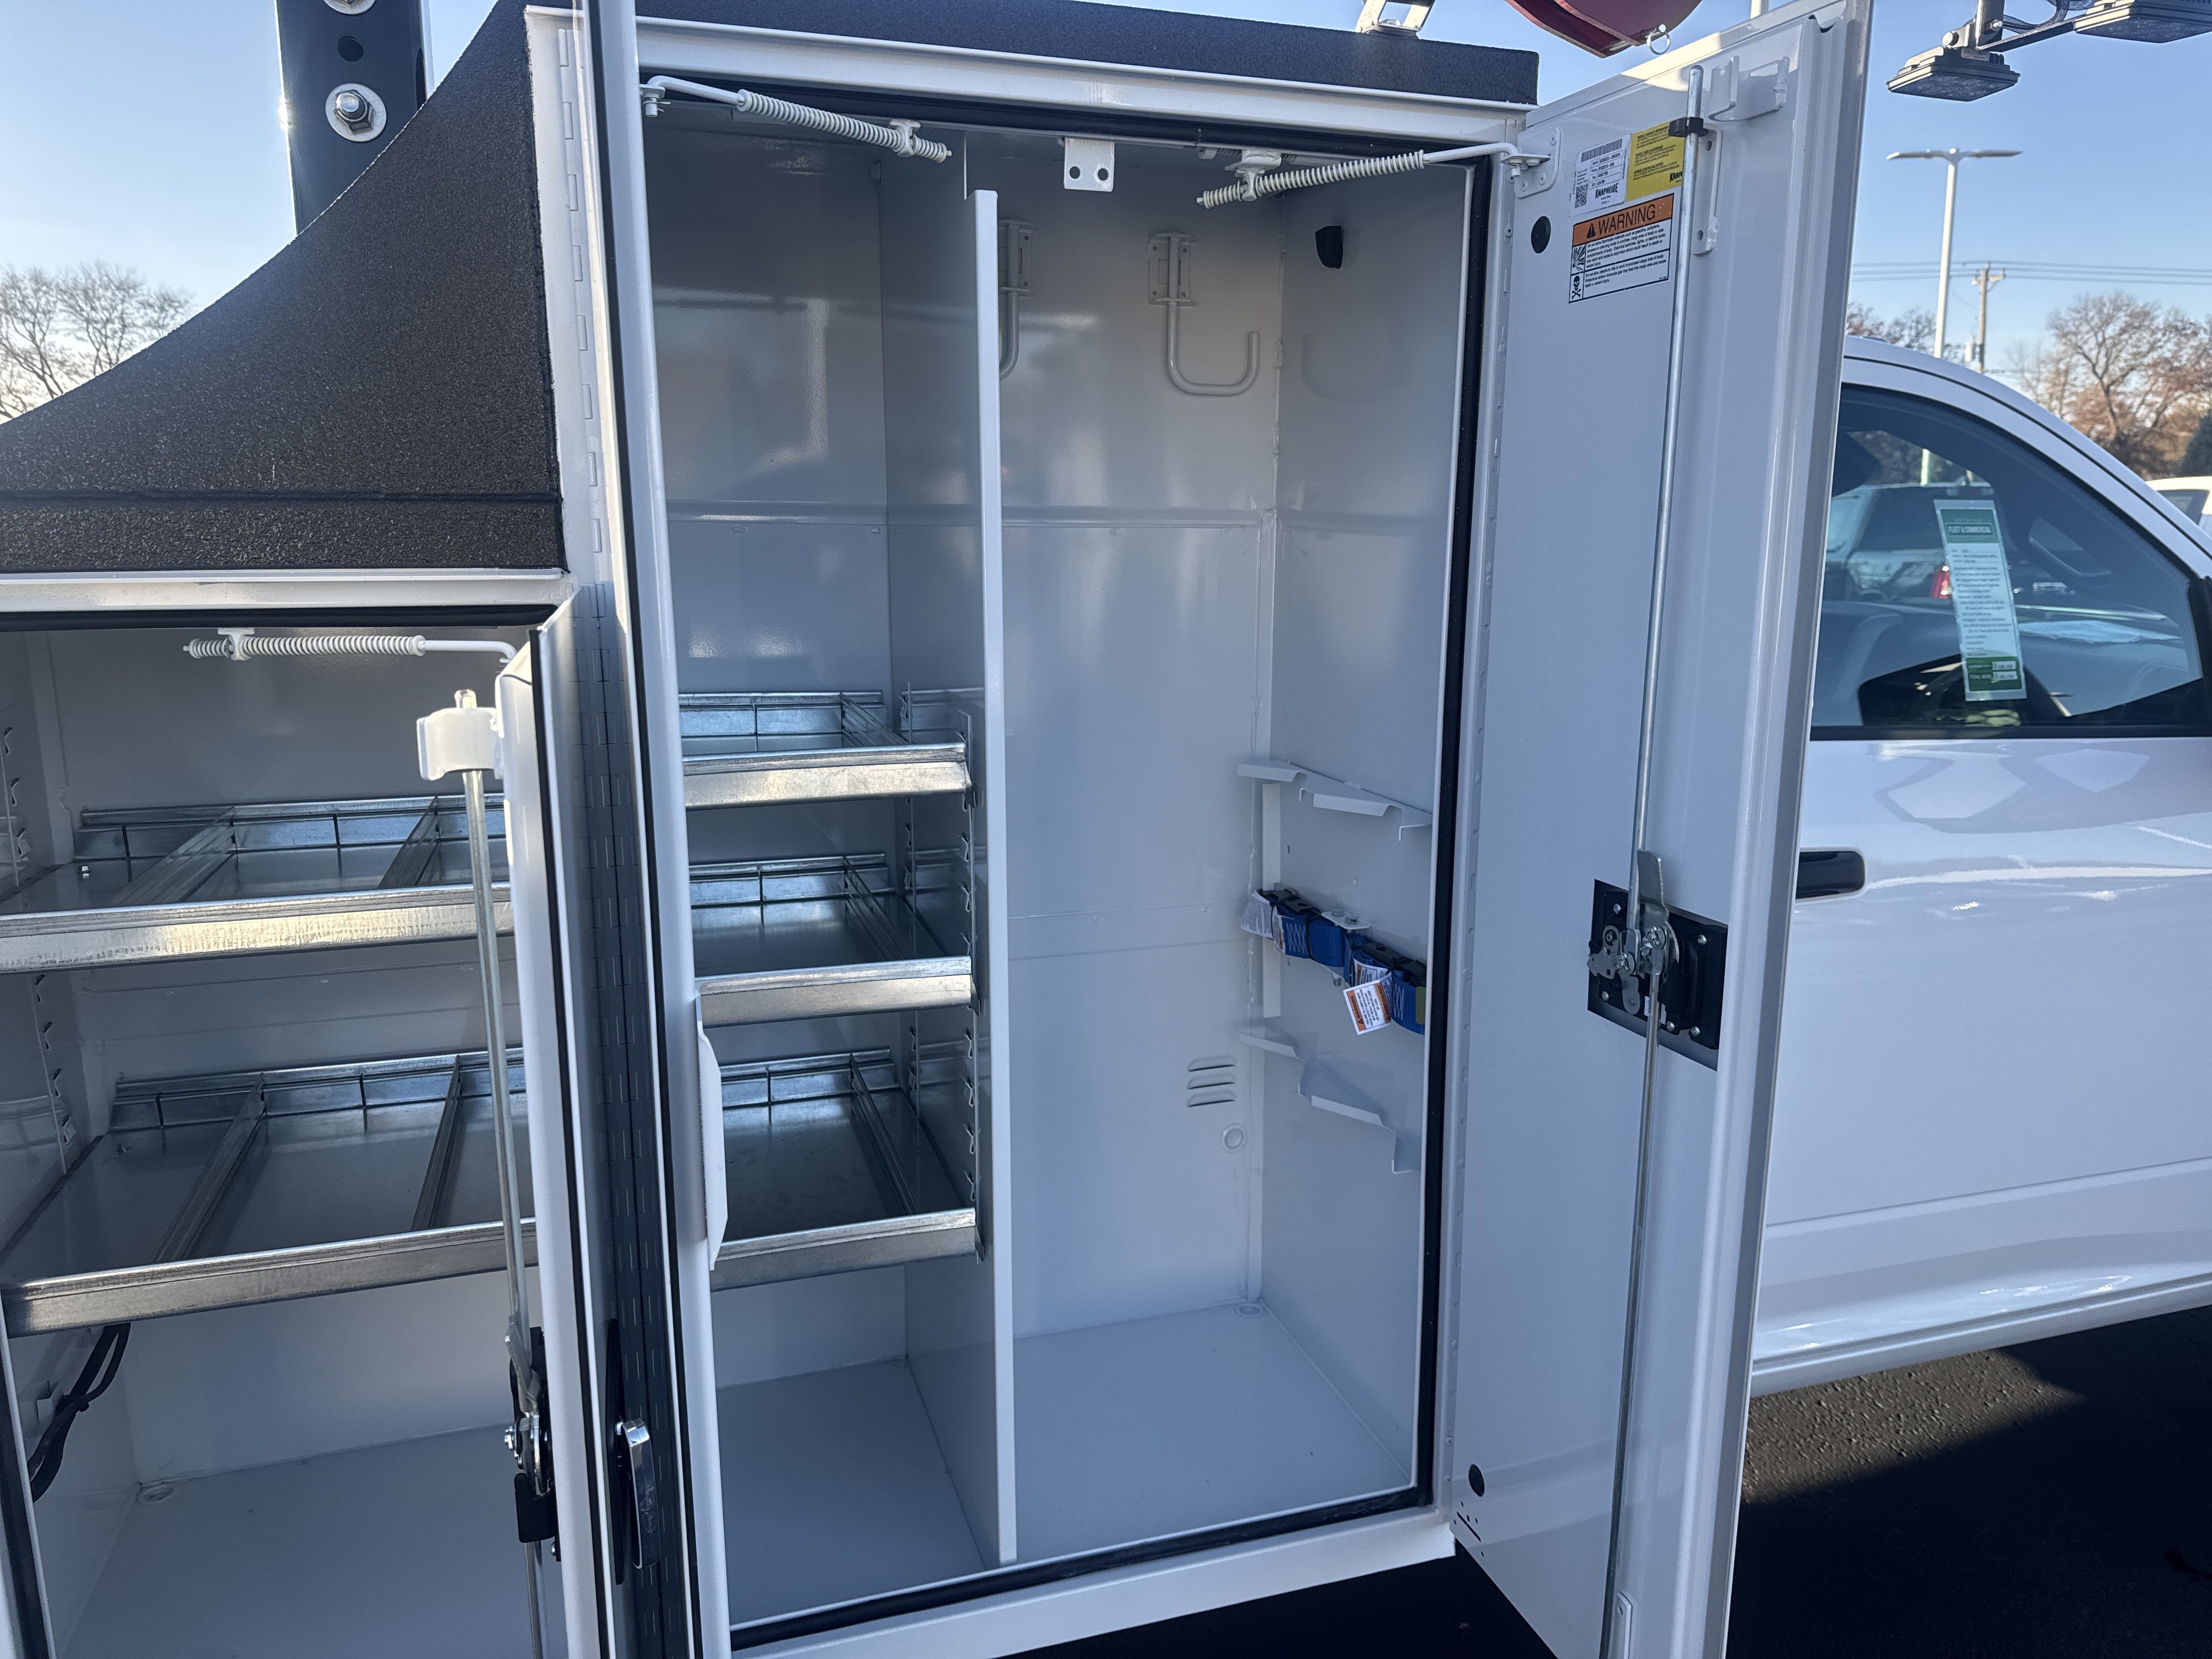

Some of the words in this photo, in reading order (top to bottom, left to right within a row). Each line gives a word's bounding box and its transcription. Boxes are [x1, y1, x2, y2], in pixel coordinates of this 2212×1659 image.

[1595, 182, 1619, 199] KNAPHEIDE
[1599, 204, 1656, 235] WARNING
[1350, 995, 1361, 1019] WARNING
